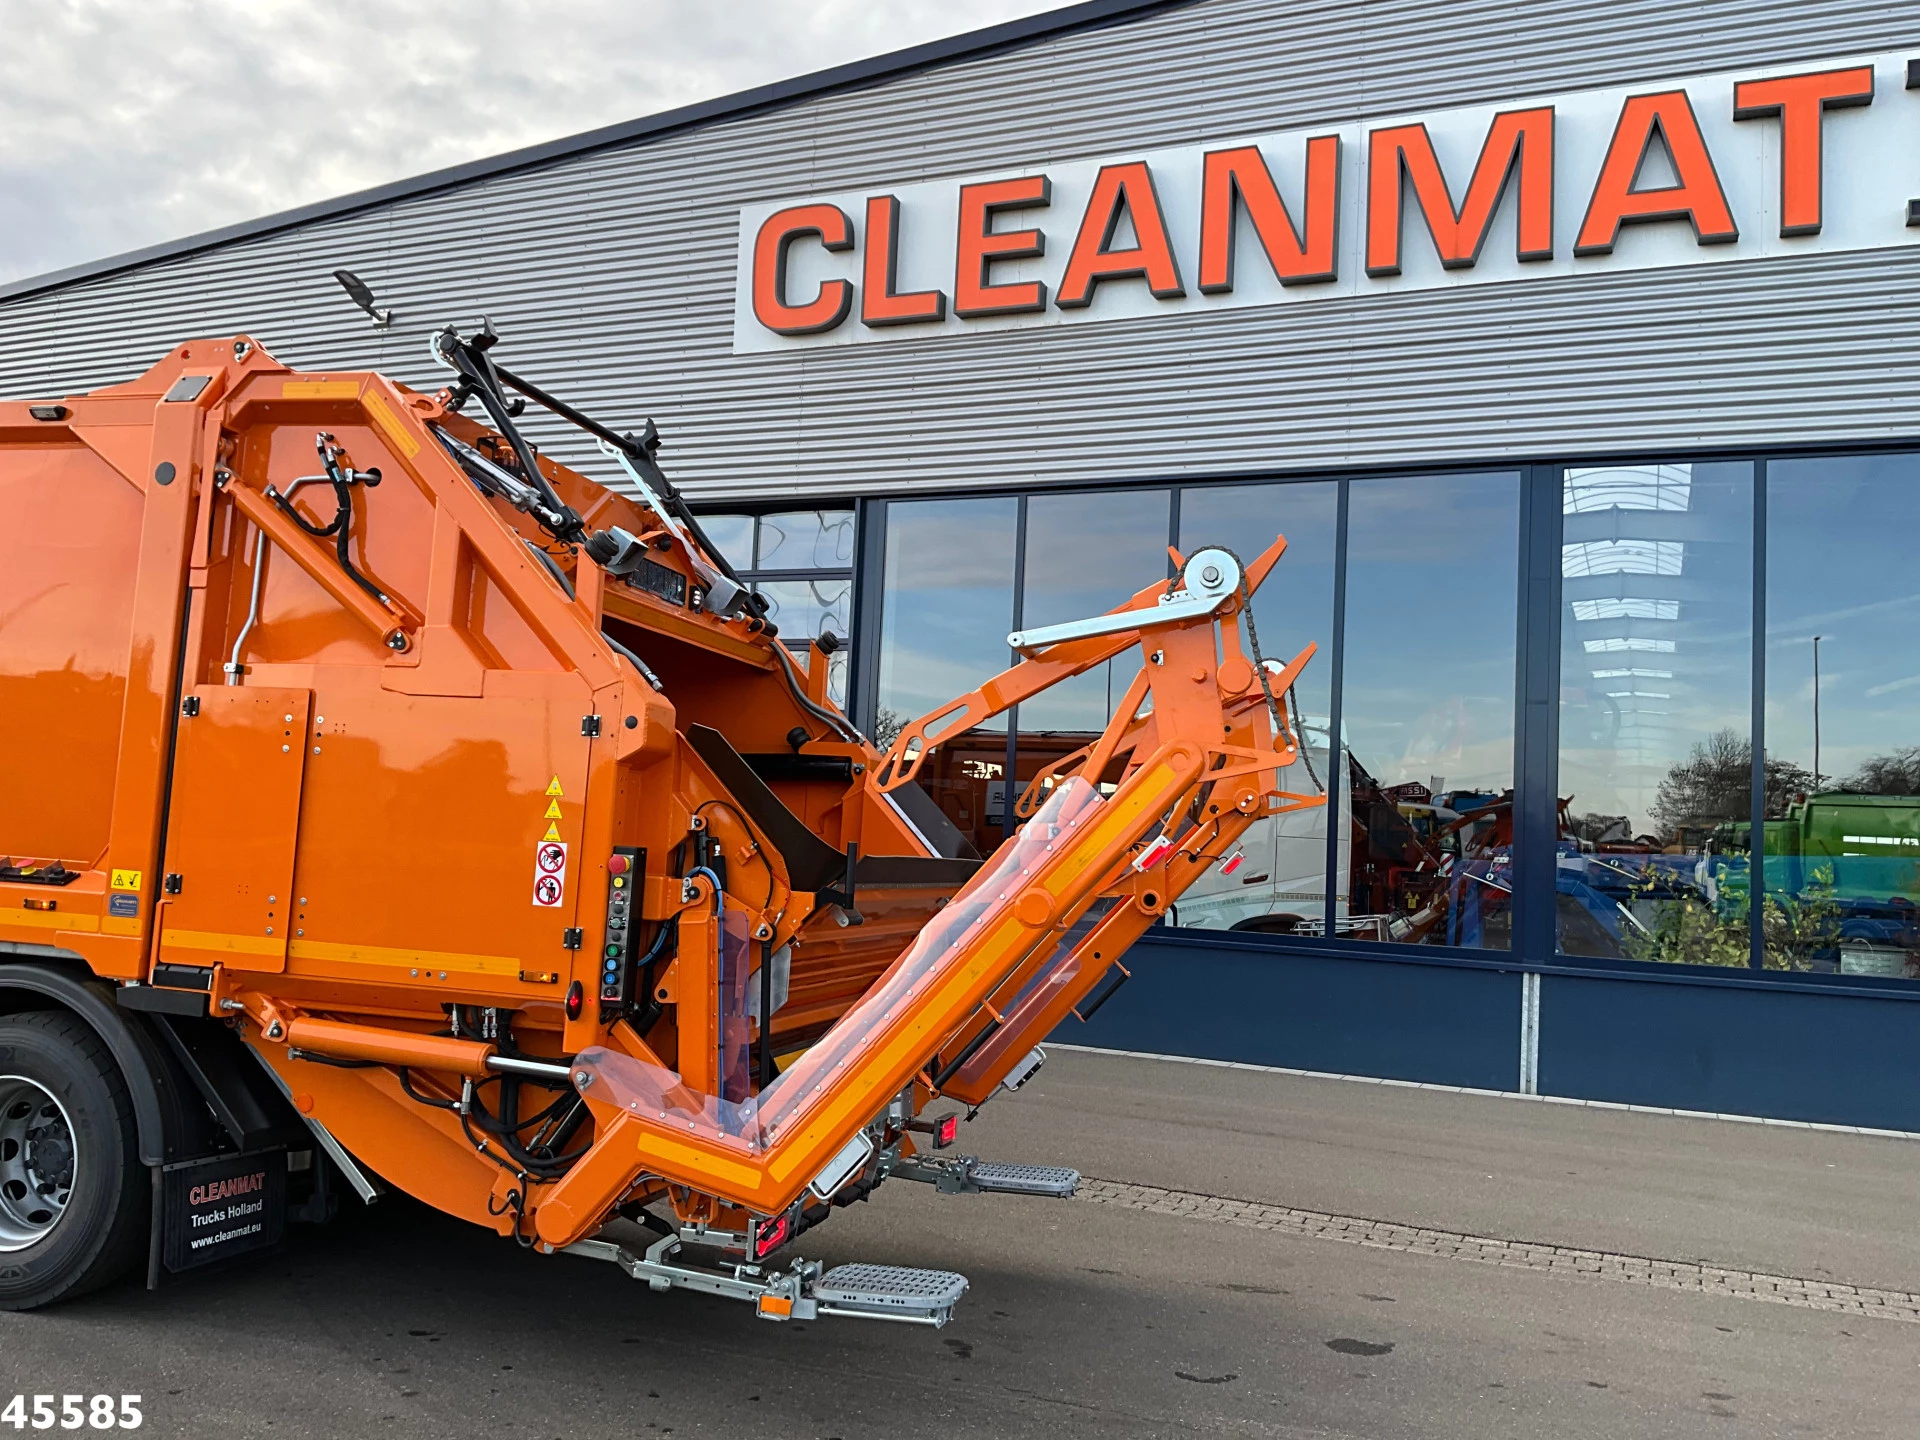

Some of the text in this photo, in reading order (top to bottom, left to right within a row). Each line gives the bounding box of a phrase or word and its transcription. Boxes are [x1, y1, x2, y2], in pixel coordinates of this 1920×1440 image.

[752, 64, 1874, 336] CLEANMAT
[189, 1172, 265, 1205] CLEANMAT
[191, 1199, 263, 1228] Trucks Holland
[191, 1223, 262, 1249] www.cleanmat.eu
